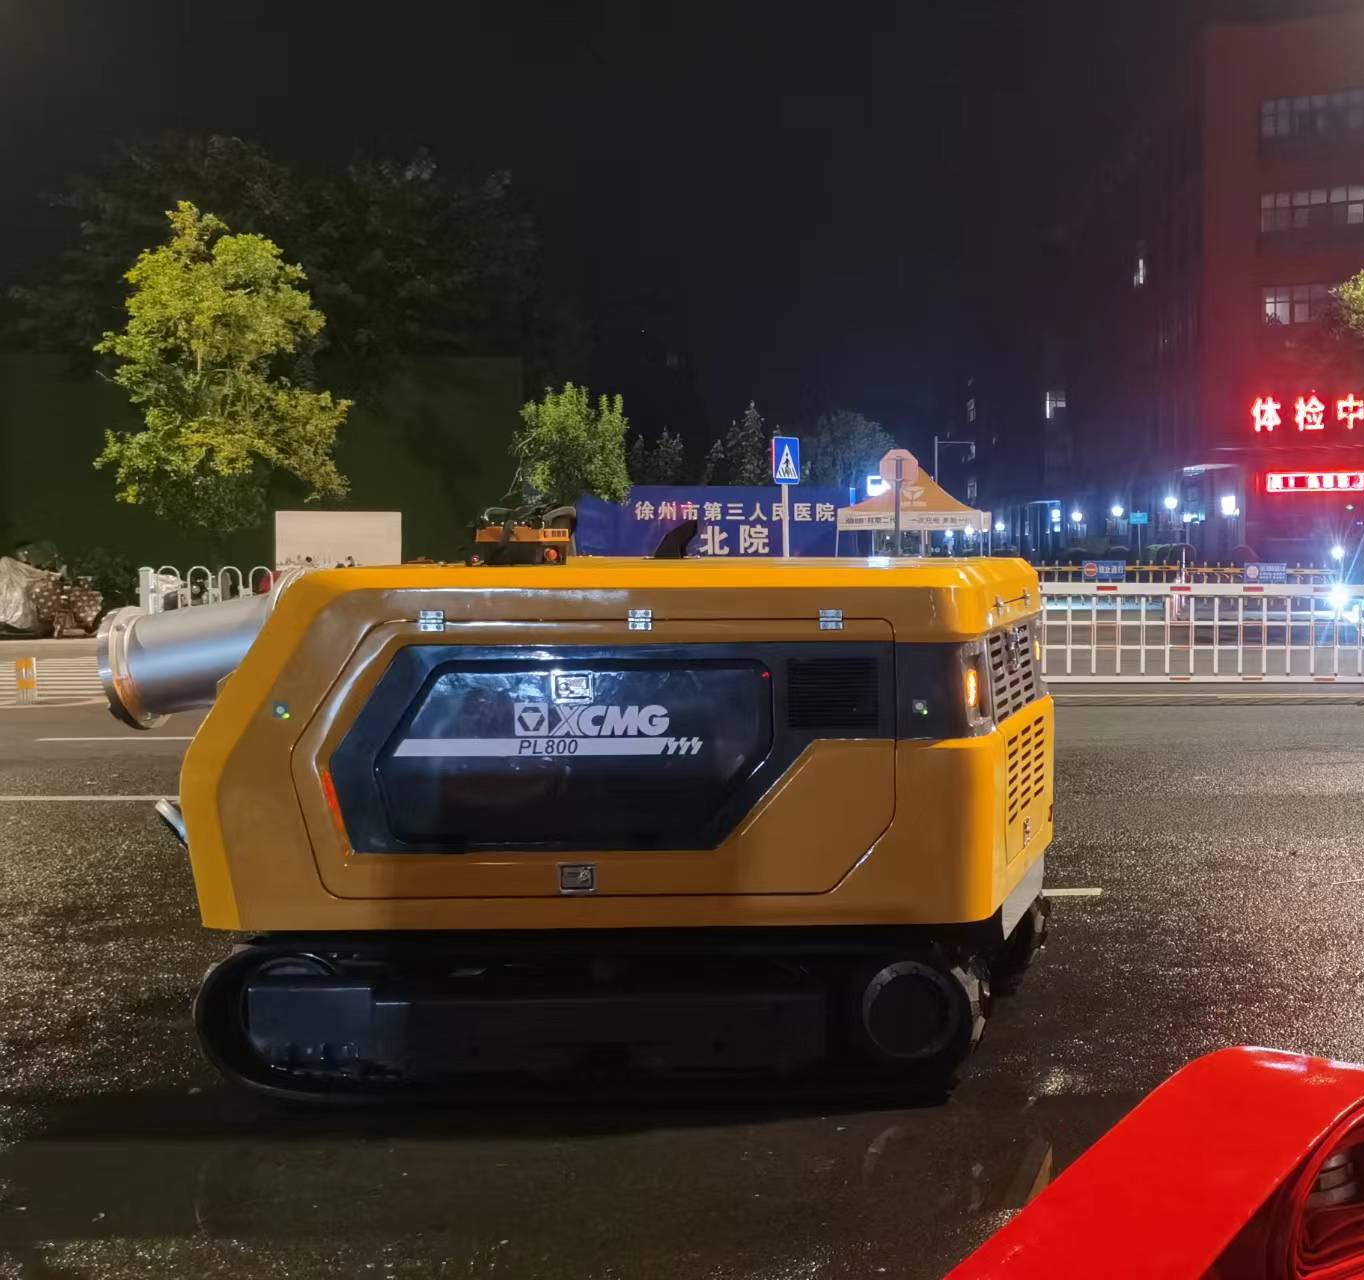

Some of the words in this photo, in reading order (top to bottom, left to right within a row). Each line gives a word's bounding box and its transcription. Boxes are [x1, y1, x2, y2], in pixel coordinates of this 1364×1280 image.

[635, 501, 836, 522] 徐州市第三人民医院
[699, 524, 770, 555] 北院
[549, 704, 670, 737] XCMG
[518, 739, 579, 755] PL800
